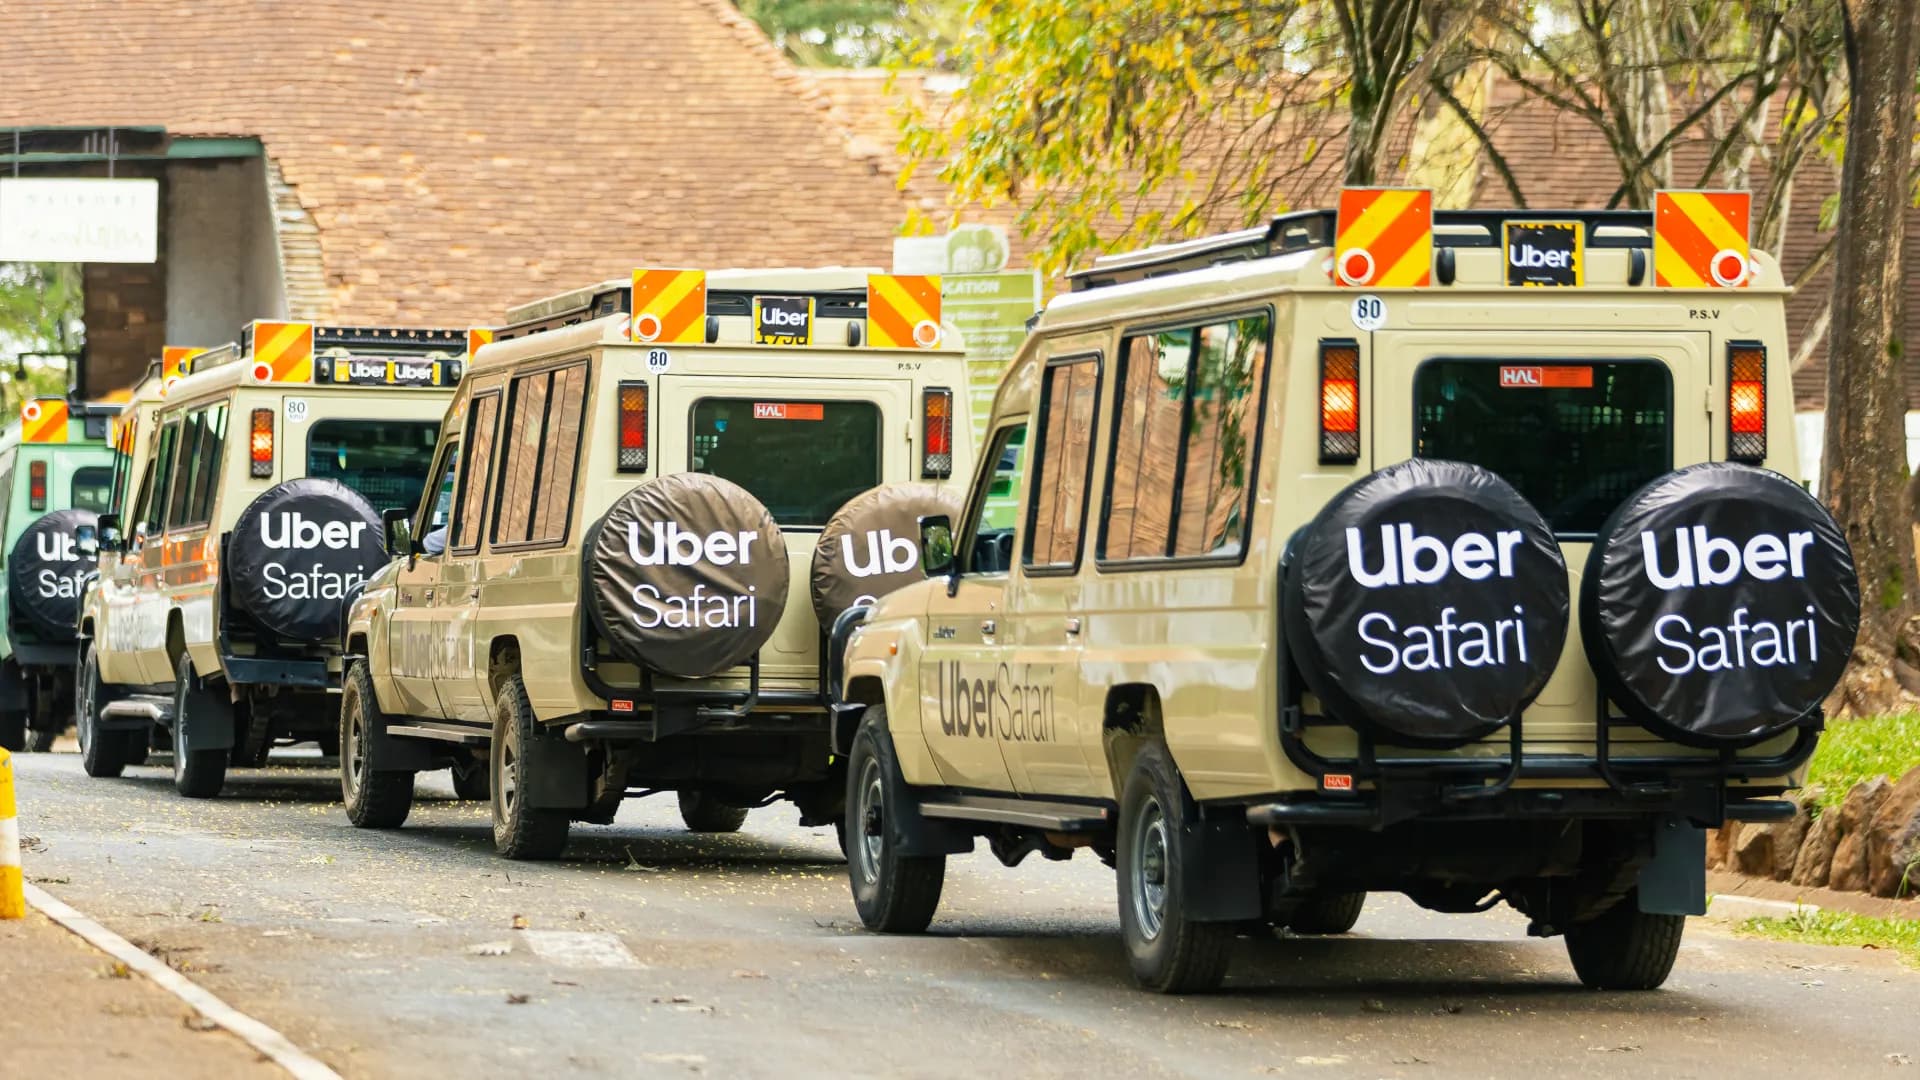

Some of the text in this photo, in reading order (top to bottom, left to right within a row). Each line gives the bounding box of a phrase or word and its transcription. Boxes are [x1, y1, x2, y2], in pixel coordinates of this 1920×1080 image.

[1509, 243, 1571, 267] Uber
[762, 307, 808, 326] Uber
[1358, 299, 1380, 318] 80
[1689, 309, 1720, 319] P.S.V
[349, 362, 386, 378] Uber
[395, 364, 432, 380] Uber
[650, 351, 667, 366] 80
[1503, 369, 1538, 384] HAL
[288, 402, 305, 413] 80
[756, 406, 783, 417] HAL
[261, 511, 367, 549] Uber
[627, 521, 758, 566] Uber
[37, 532, 99, 561] Ub
[841, 529, 919, 578] Ub
[1346, 522, 1524, 589] Uber
[1640, 525, 1814, 591] Uber
[38, 569, 84, 598] Saf
[263, 562, 364, 600] Safari
[631, 584, 756, 629] Safari
[1357, 605, 1528, 675] Safari
[1653, 606, 1818, 675] Safari
